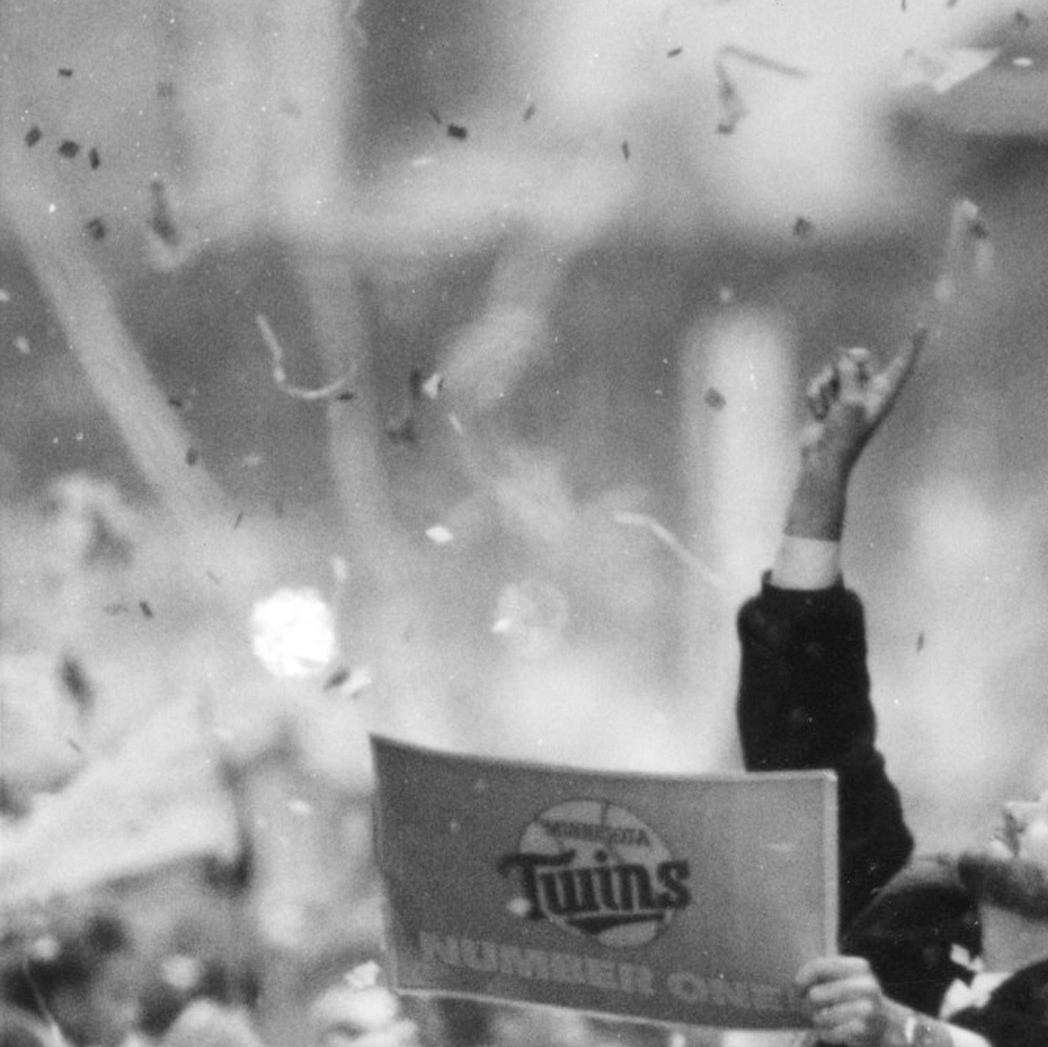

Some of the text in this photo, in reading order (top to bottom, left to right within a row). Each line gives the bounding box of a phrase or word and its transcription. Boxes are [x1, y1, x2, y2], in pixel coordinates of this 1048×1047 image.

[543, 819, 651, 846] MINNESOTA
[497, 849, 692, 921] Twins
[419, 931, 654, 996] NUMBER
